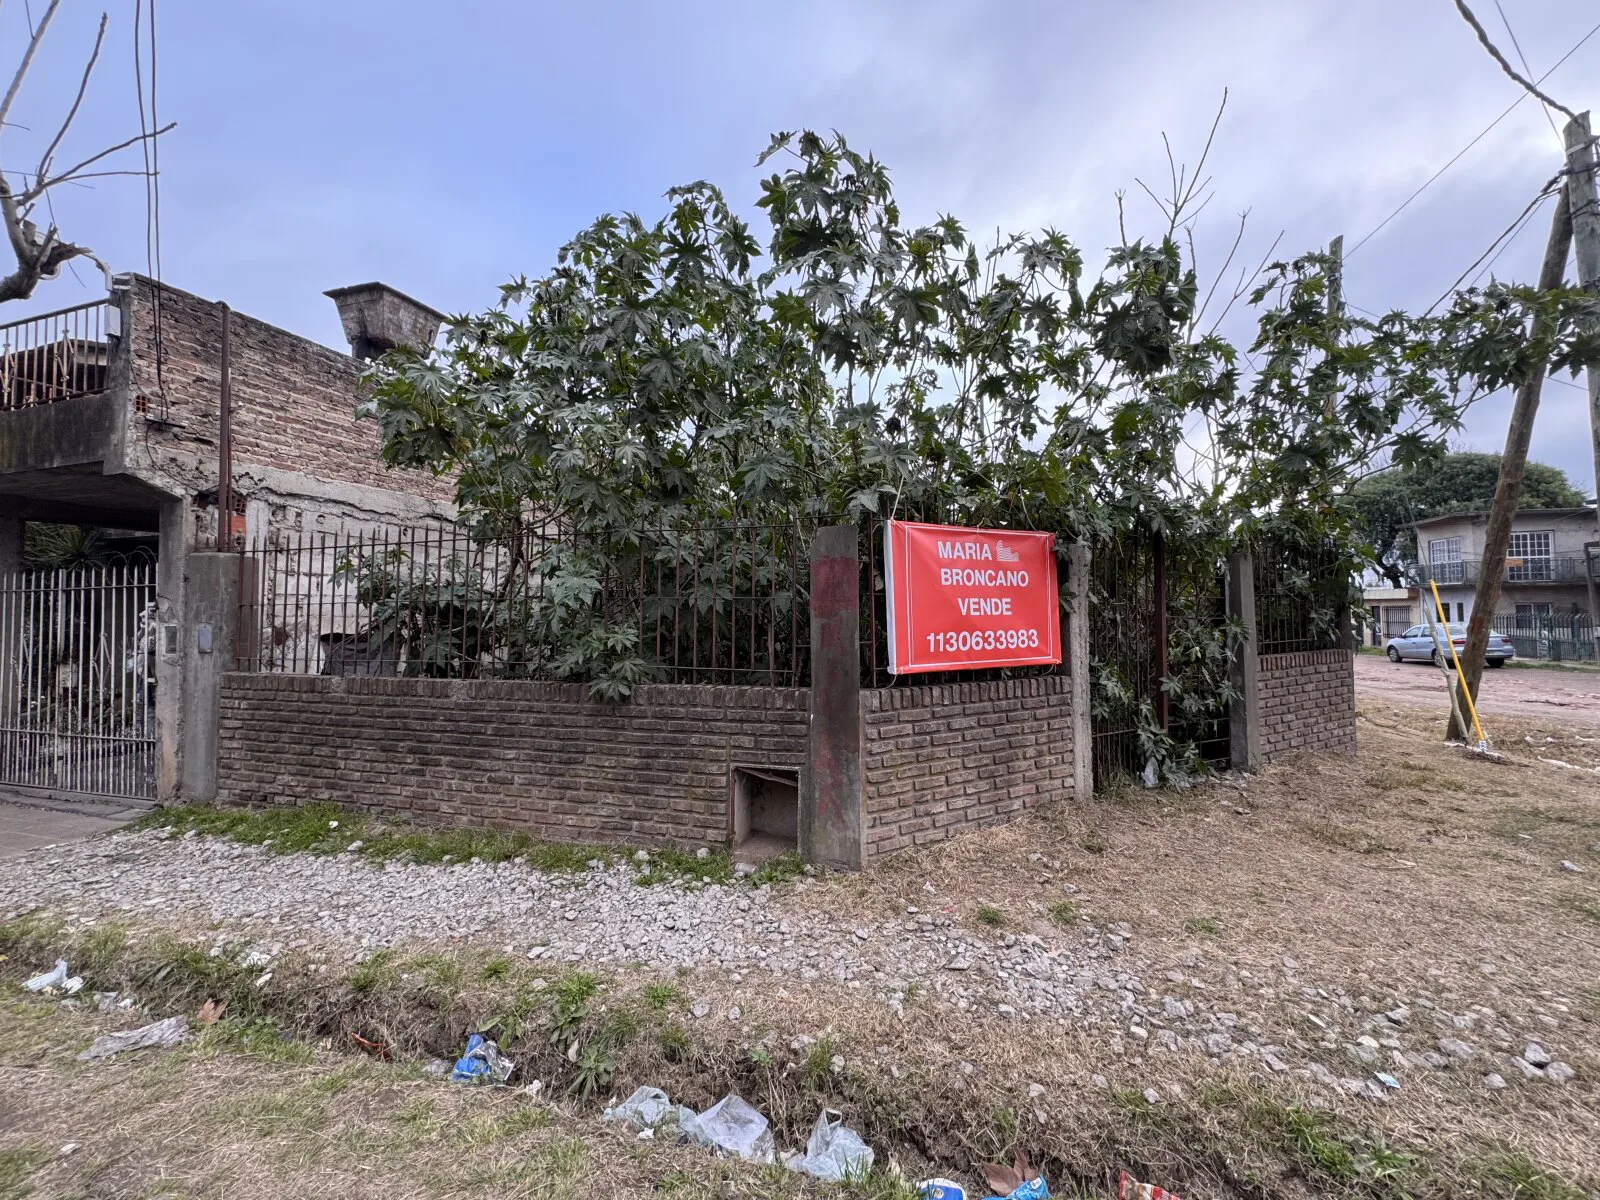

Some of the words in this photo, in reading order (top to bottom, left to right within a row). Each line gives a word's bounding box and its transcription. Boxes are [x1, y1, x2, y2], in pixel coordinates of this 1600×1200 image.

[937, 541, 992, 560] MARIA
[941, 568, 1029, 587] BRONCANO
[957, 597, 1012, 615] VENDE
[926, 629, 1039, 652] 1130633983
